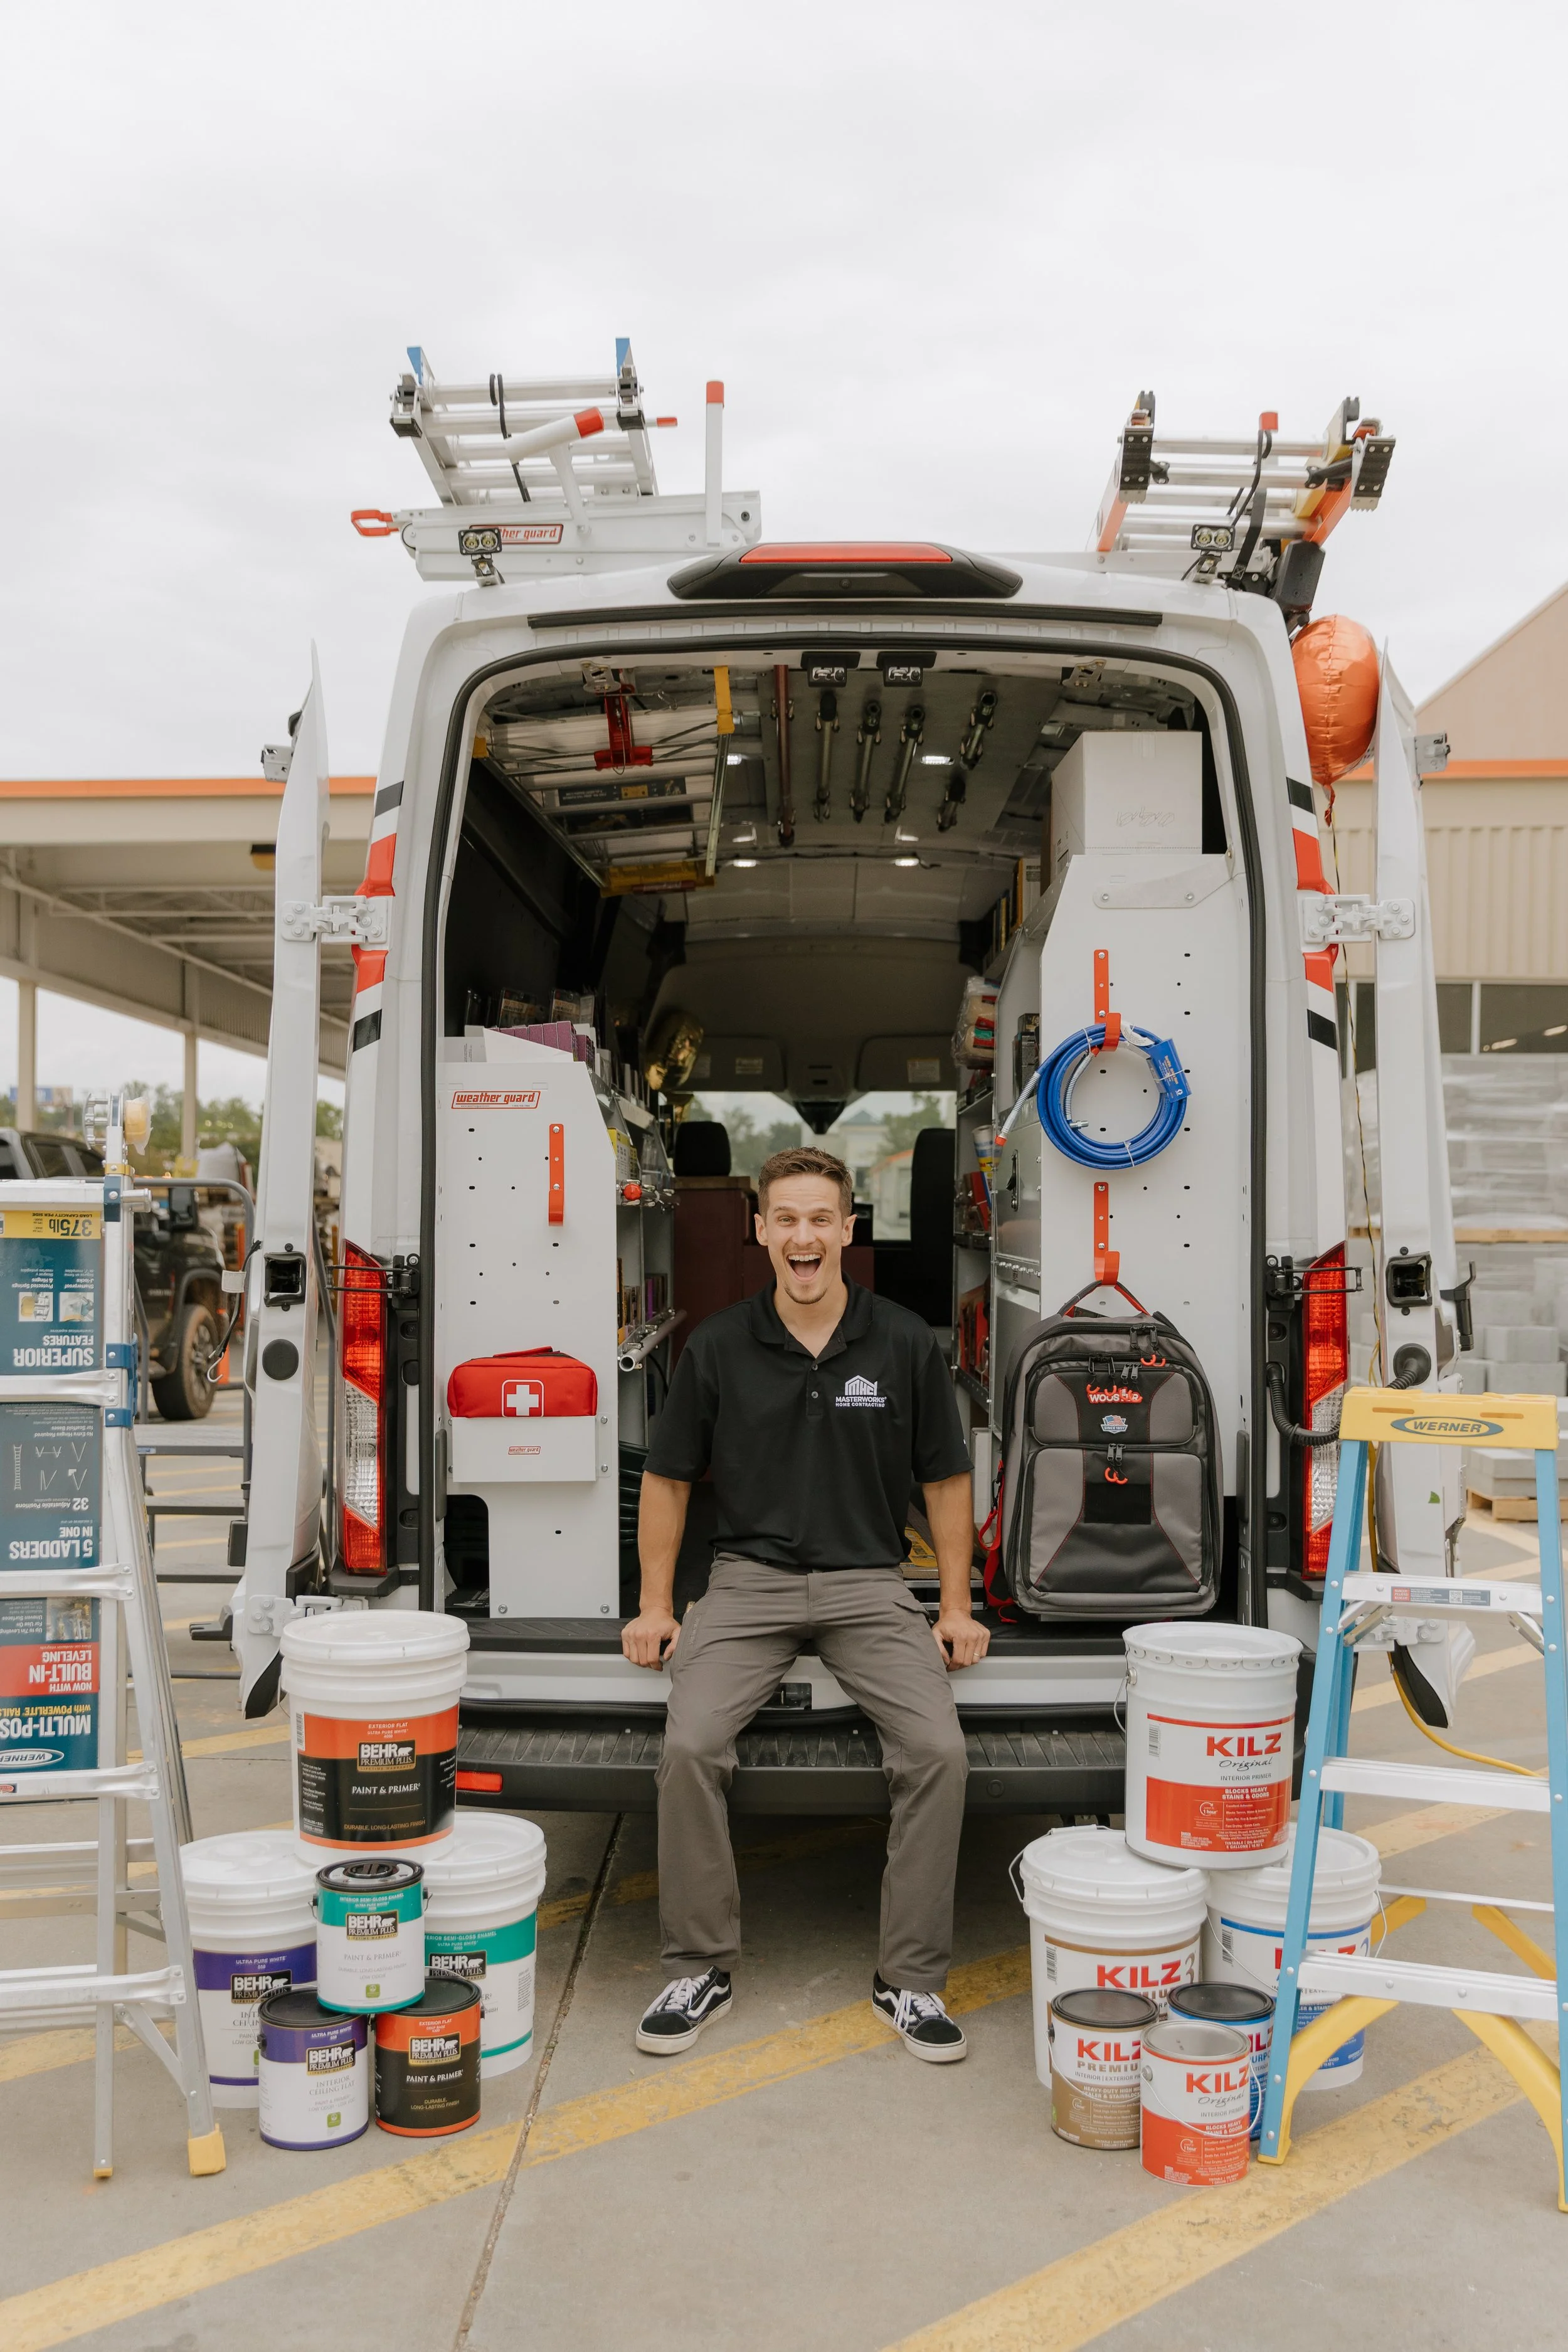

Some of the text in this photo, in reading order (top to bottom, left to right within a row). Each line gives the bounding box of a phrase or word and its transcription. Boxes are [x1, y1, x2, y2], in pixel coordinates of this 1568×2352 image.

[524, 528, 557, 539] guard
[456, 1093, 535, 1104] weather guard
[49, 1219, 92, 1237] 375lb
[42, 1335, 94, 1346] FEATURES
[13, 1348, 94, 1367] SUPERIOR
[1414, 1421, 1482, 1433] WERNER
[72, 1497, 89, 1510] 32
[60, 1526, 93, 1538] IN ONE
[9, 1539, 93, 1559] 5 LADDERS
[42, 1650, 92, 1663] LEVELING
[29, 1663, 92, 1683] BUILT-IN
[49, 1682, 92, 1692] NOW WITH
[74, 1705, 91, 1713] with
[361, 1743, 398, 1759] BEHR
[1207, 1732, 1282, 1757] KILZ
[361, 1756, 413, 1766] PREMIUM PLUS
[1219, 1756, 1273, 1771] Original
[352, 1786, 378, 1794] PAINT
[371, 1822, 410, 1830] LONG-LASTING
[348, 1915, 382, 1929] BEHR
[349, 1926, 395, 1936] PREMIUM PLUS
[432, 1955, 469, 1970] BEHR
[466, 1968, 483, 1976] PLUS
[1097, 1959, 1182, 1989] KILZ
[234, 1975, 272, 1991] BEHR
[339, 2026, 352, 2034] WHITE
[411, 2038, 445, 2052] BEHR
[309, 2046, 342, 2063] BEHR
[411, 2048, 458, 2059] PREMIUM PLUS
[309, 2055, 354, 2070] PREMIUM PLUS
[1077, 2060, 1139, 2072] PREMIU
[317, 2075, 350, 2088] INTERIOR
[1074, 2070, 1101, 2080] INTERIOR
[1186, 2063, 1249, 2094] KILZ
[309, 2080, 356, 2096] CEILING FLAT
[1083, 2085, 1119, 2094] HEAVY-DUTY
[1198, 2089, 1246, 2107] Original
[1227, 2119, 1241, 2128] HEAVY
